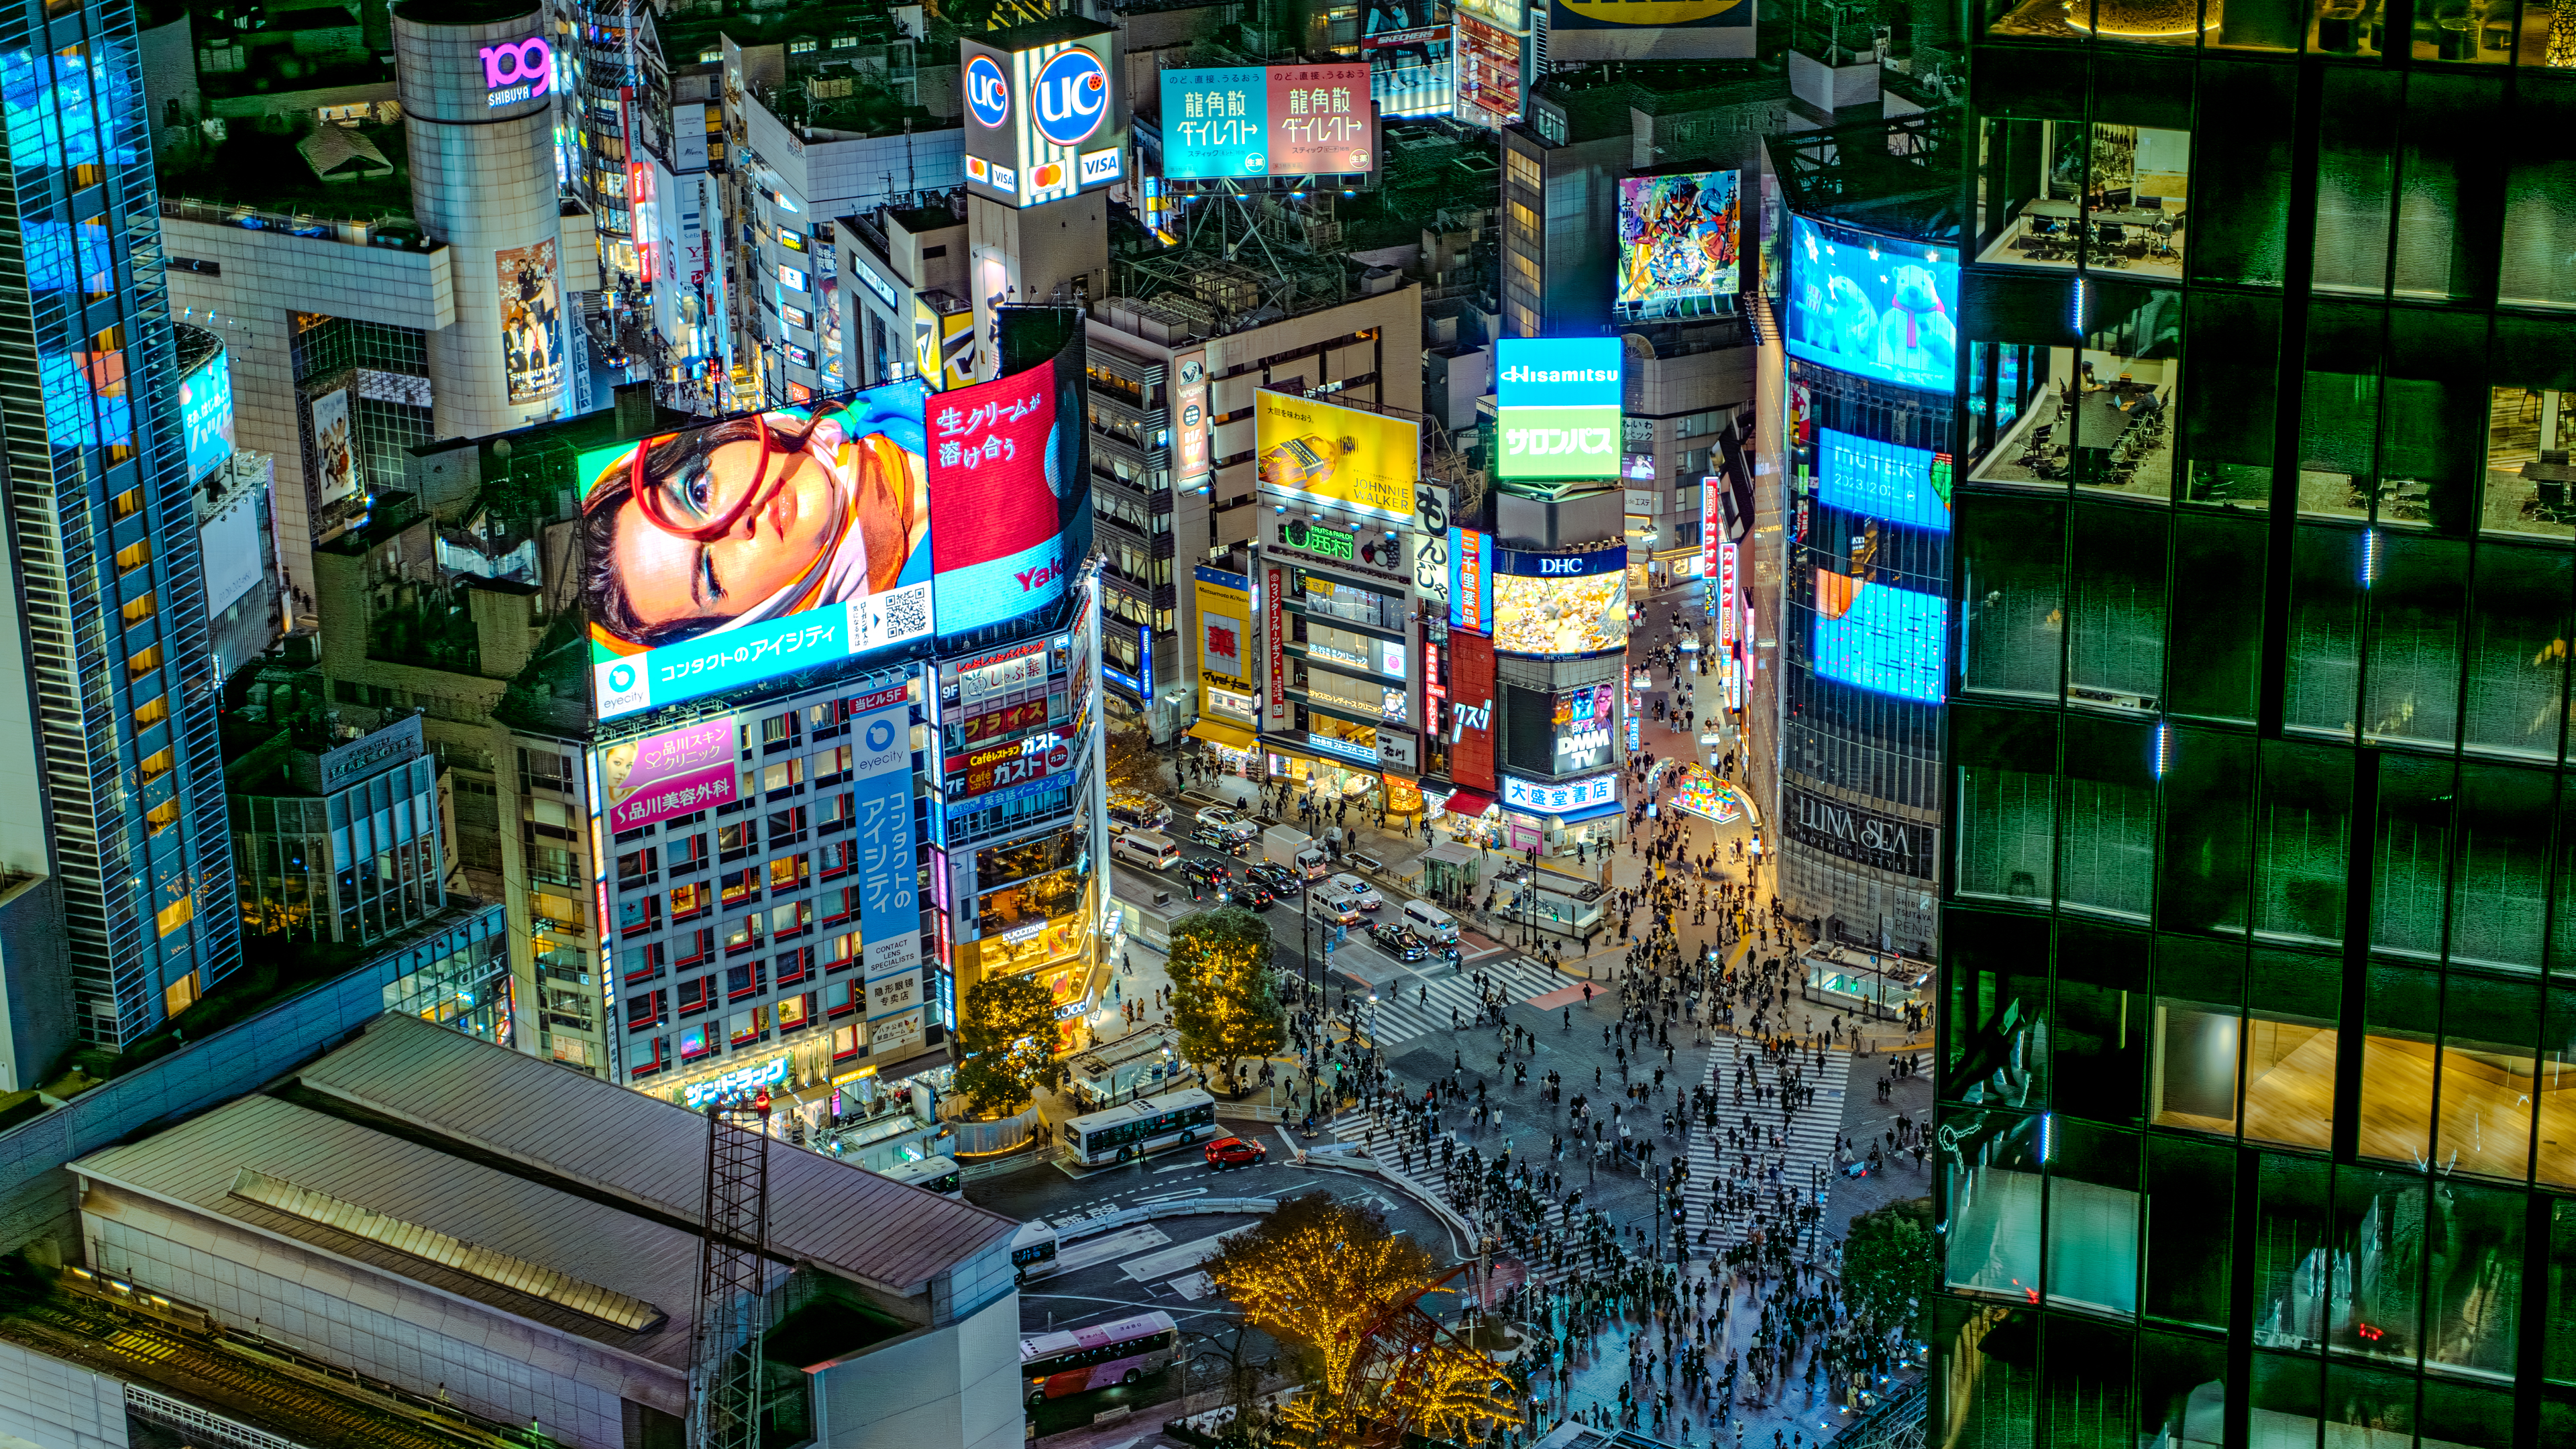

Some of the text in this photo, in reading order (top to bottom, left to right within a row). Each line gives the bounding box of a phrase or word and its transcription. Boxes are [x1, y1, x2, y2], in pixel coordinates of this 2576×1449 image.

[1377, 30, 1434, 44] SKECHERS
[480, 38, 550, 97] 109
[1275, 70, 1365, 80] のど、直接、うるおう
[1169, 74, 1260, 85] のど、直接、うるおう
[488, 85, 530, 108] SHIBUYA
[1185, 90, 1246, 118] 龍角散
[1290, 87, 1350, 114] 龍角散
[1177, 119, 1258, 146] ダイレクト
[1282, 115, 1362, 143] ダイレクト
[1083, 156, 1117, 174] VISA
[1188, 150, 1219, 158] スティック
[1247, 158, 1264, 167] 生薬
[1351, 154, 1368, 163] 生薬
[994, 170, 1013, 186] VISA
[1036, 184, 1061, 193] mastercard
[510, 361, 564, 381] SHIBUYA109
[1501, 365, 1618, 382] Hisamitsu
[936, 392, 1040, 436] 生クリームが
[1267, 407, 1314, 424] 大胆を味わおう。
[938, 434, 1016, 470] 溶け合う
[1506, 427, 1613, 455] サロンパス
[1354, 478, 1409, 499] JOHNNIE
[1354, 489, 1408, 511] WALKER
[1311, 534, 1354, 560] 西村
[1416, 486, 1448, 600] もんじゃ
[1705, 523, 1716, 571] カラオケ
[1014, 557, 1065, 592] Yak
[1541, 558, 1582, 573] DHC
[1723, 551, 1733, 602] カラオケ
[1463, 536, 1476, 625] 三千里薬品
[1198, 586, 1230, 599] Matsumoto
[1271, 584, 1281, 668] ウィンターフルーツギフト
[1055, 636, 1069, 647] 寿司
[1208, 625, 1236, 657] 薬
[661, 625, 837, 682] コンタクトのアイシティ
[957, 641, 1046, 672] しゃぶしゃぶバイキング
[991, 659, 1040, 687] しゃぶ葉
[604, 690, 643, 709] eyecity
[855, 688, 902, 711] 当ビル5F
[943, 684, 958, 698] 9F
[1358, 702, 1383, 714] クリニック
[662, 729, 726, 757] 品川スキン
[970, 732, 1061, 766] Caféレストラン ガスト
[1558, 729, 1610, 756] DMM
[663, 745, 720, 771] クリニック
[859, 750, 904, 771] eyecity
[1051, 753, 1067, 763] ガスト
[1571, 749, 1597, 769] TV
[969, 771, 991, 784] Café
[994, 757, 1041, 787] ガスト
[947, 777, 965, 794] 7F
[984, 778, 1055, 807] 英会話イーオン
[1511, 782, 1608, 806] 大盛堂書店
[629, 777, 730, 821] 品川美容外科
[953, 800, 977, 815] AEON
[1799, 796, 1913, 857] LUNA SEA
[861, 797, 890, 913] アイシティ
[890, 792, 911, 908] コンタクトの
[1800, 833, 1853, 857] MOTHER
[1897, 908, 1932, 921] TSUTAYA
[1002, 922, 1046, 941] L'OCCITANE
[875, 940, 908, 954] CONTACT
[883, 949, 901, 960] LENS
[871, 953, 914, 971] SPECIALISTS
[874, 977, 914, 998] 隐形眼镜
[880, 991, 909, 1006] 专卖店
